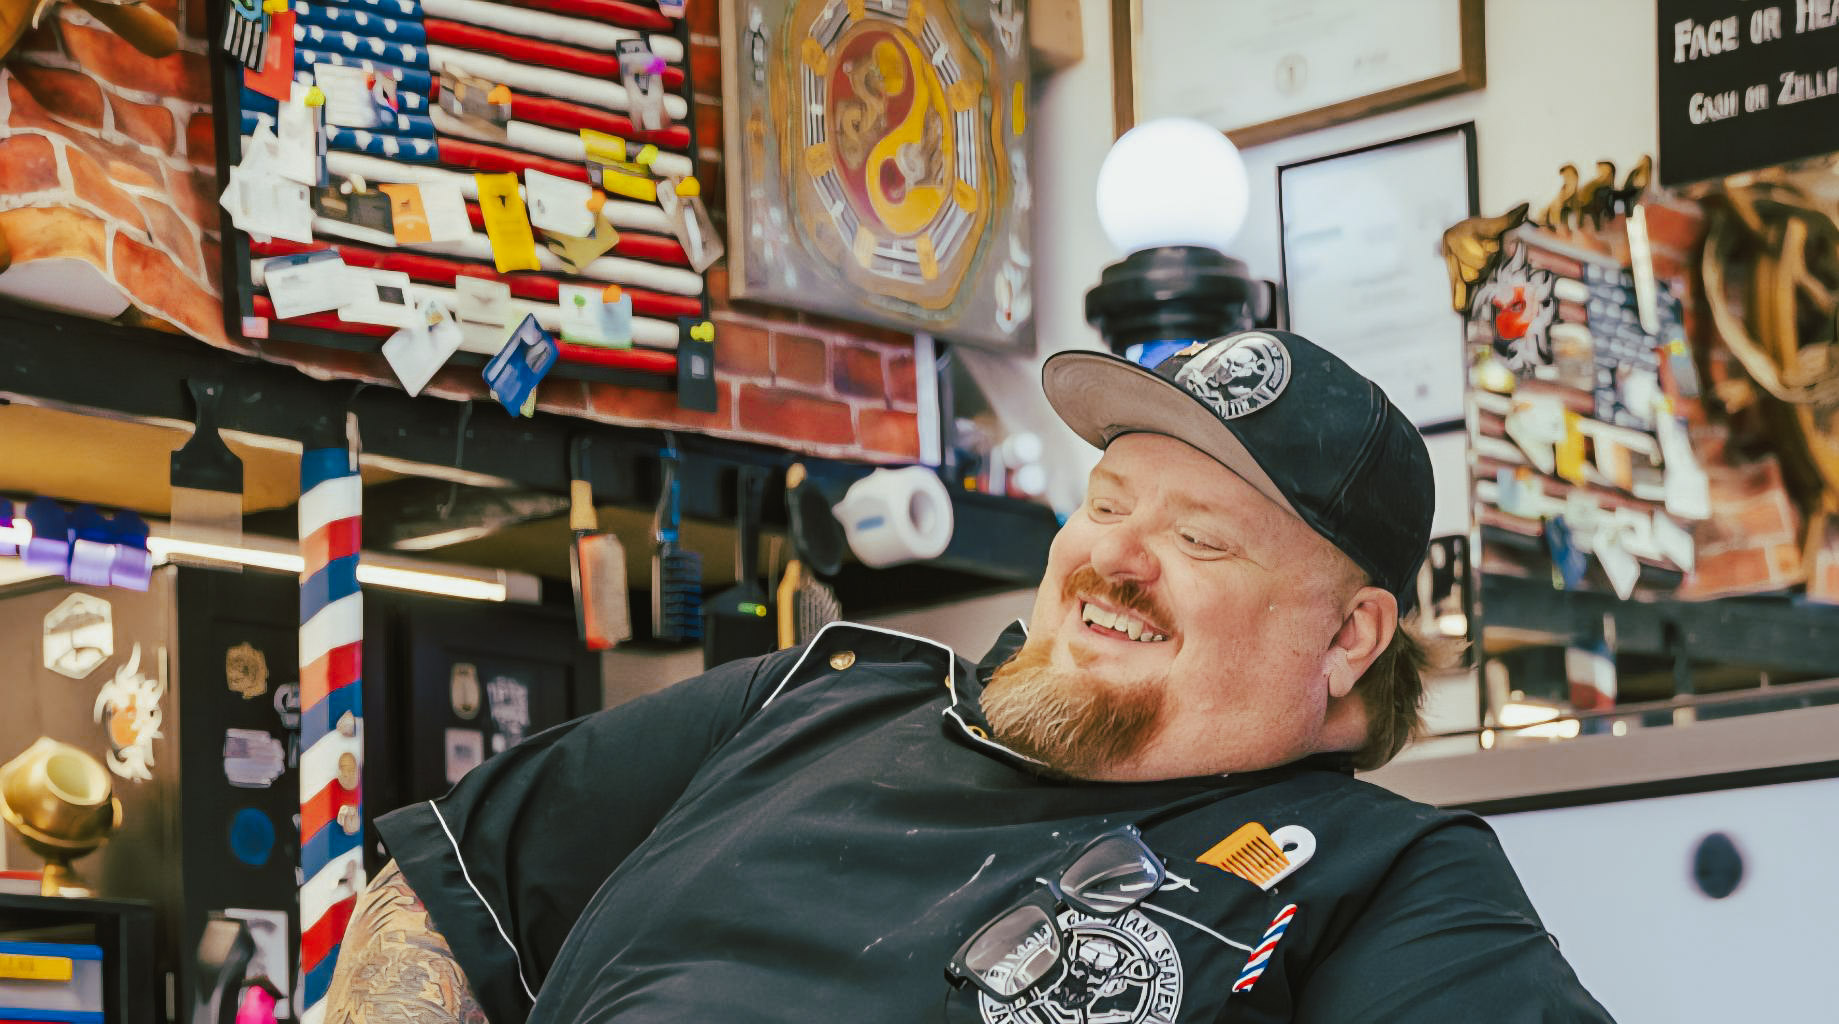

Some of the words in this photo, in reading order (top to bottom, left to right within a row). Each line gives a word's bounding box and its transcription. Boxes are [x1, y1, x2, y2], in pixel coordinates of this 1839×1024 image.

[1674, 15, 1740, 63] FACE
[1749, 6, 1782, 45] OR
[1126, 917, 1158, 943] AND
[1154, 948, 1178, 1021] SHAVES
